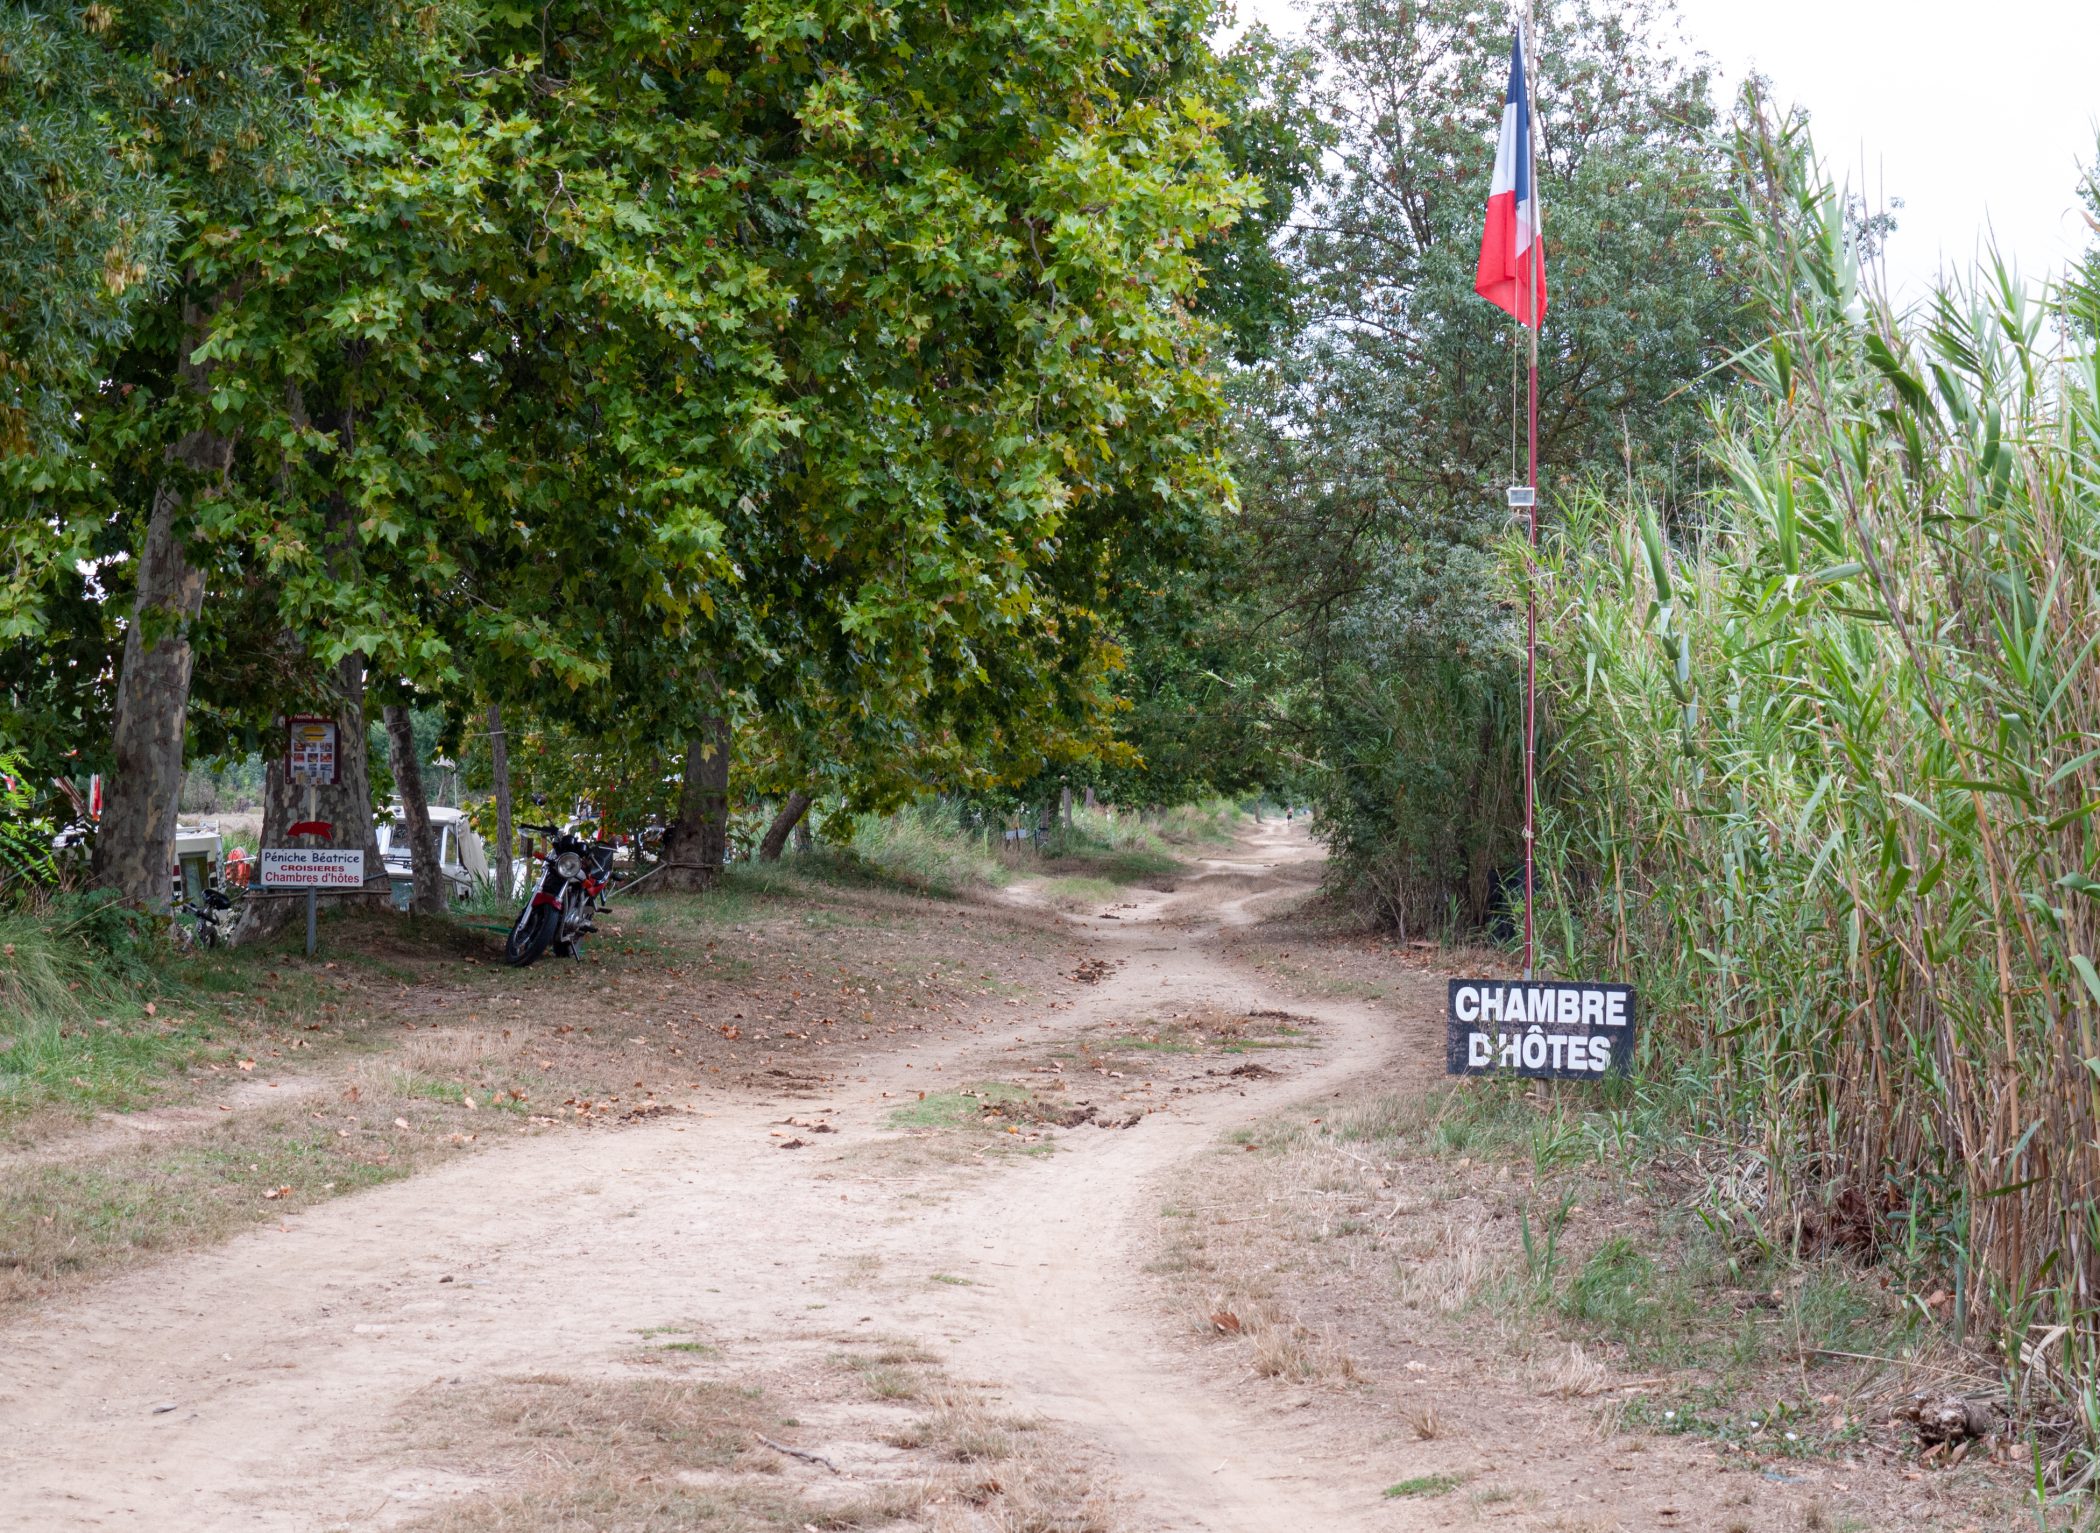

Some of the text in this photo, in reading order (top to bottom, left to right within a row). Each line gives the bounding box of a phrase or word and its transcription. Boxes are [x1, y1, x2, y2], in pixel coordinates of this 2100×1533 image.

[264, 852, 360, 863] Péniche Béatrice
[280, 864, 345, 872] CROISIERES
[265, 872, 360, 884] Chambres d'hôtes
[1455, 986, 1627, 1026] CHAMBRE
[1468, 1025, 1611, 1072] DHÔTES
